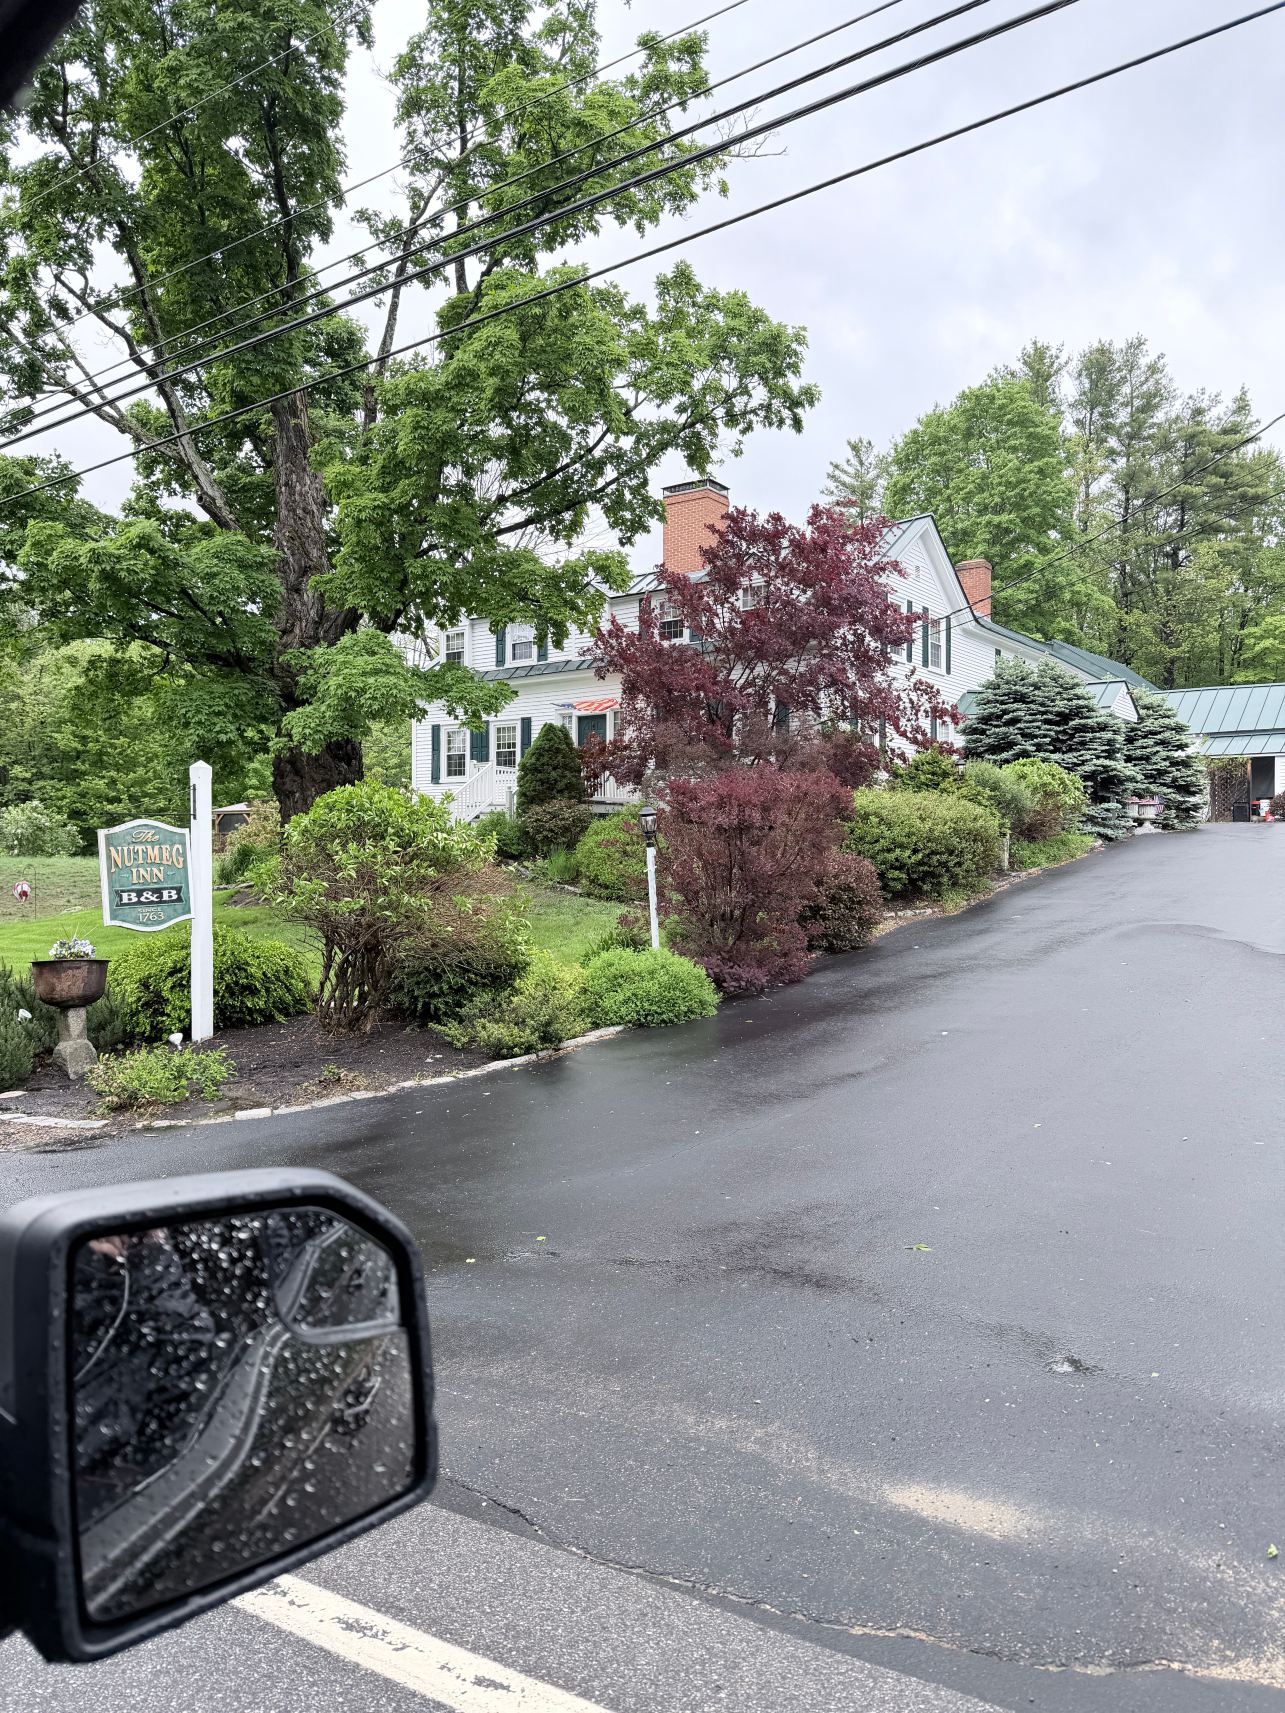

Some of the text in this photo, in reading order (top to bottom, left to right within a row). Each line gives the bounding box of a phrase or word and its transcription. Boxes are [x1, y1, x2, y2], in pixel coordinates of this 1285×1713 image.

[131, 829, 160, 842] The
[109, 844, 184, 873] NUTMEG
[131, 866, 165, 884] INN
[120, 889, 178, 904] B&B
[138, 911, 165, 922] 1763
